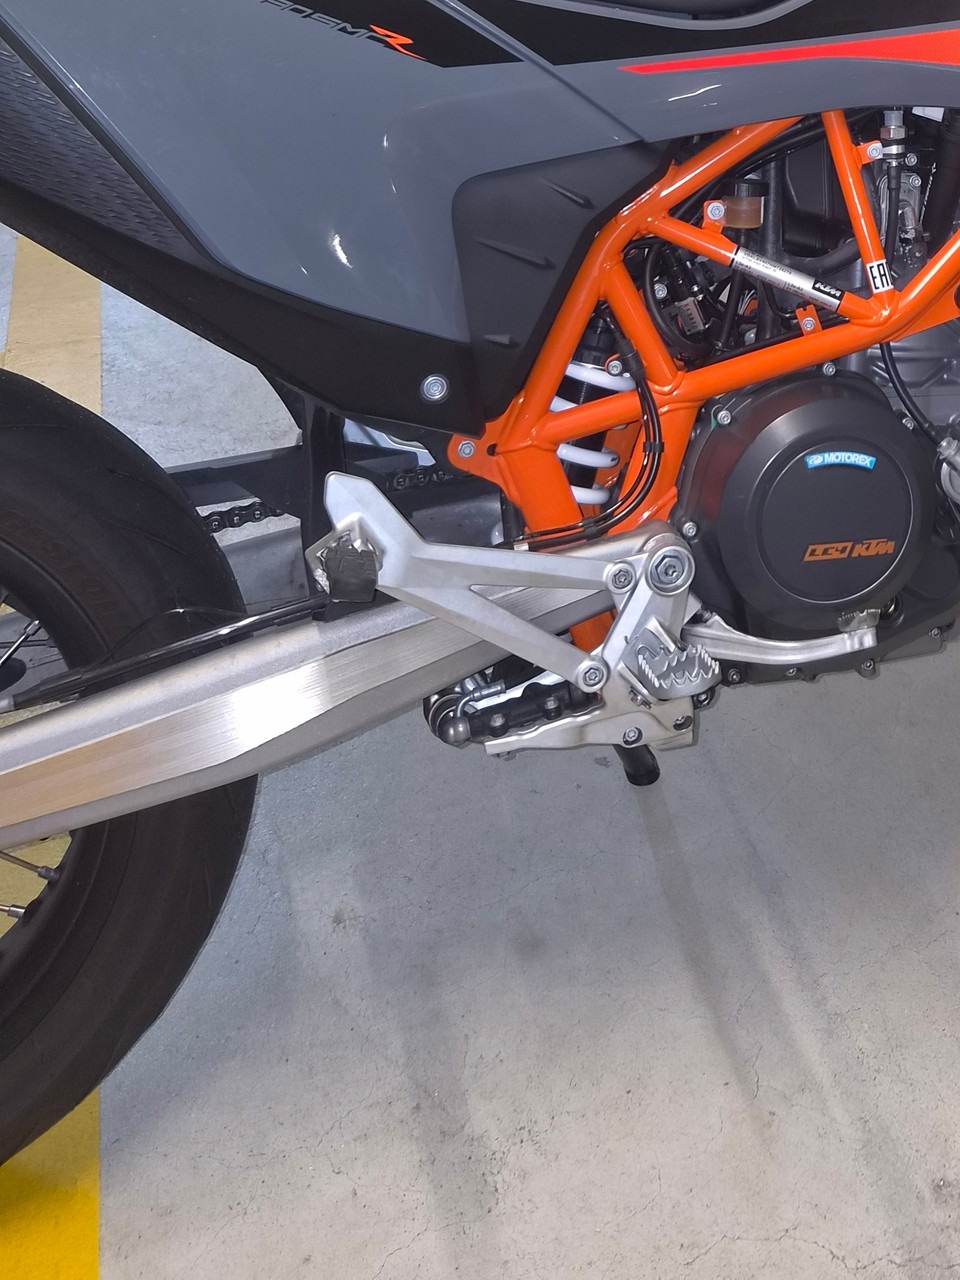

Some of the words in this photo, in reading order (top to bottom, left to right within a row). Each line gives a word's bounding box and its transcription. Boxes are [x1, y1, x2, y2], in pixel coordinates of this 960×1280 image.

[814, 281, 842, 297] KTM
[824, 452, 873, 467] MOTOREX
[851, 538, 896, 558] KTM
